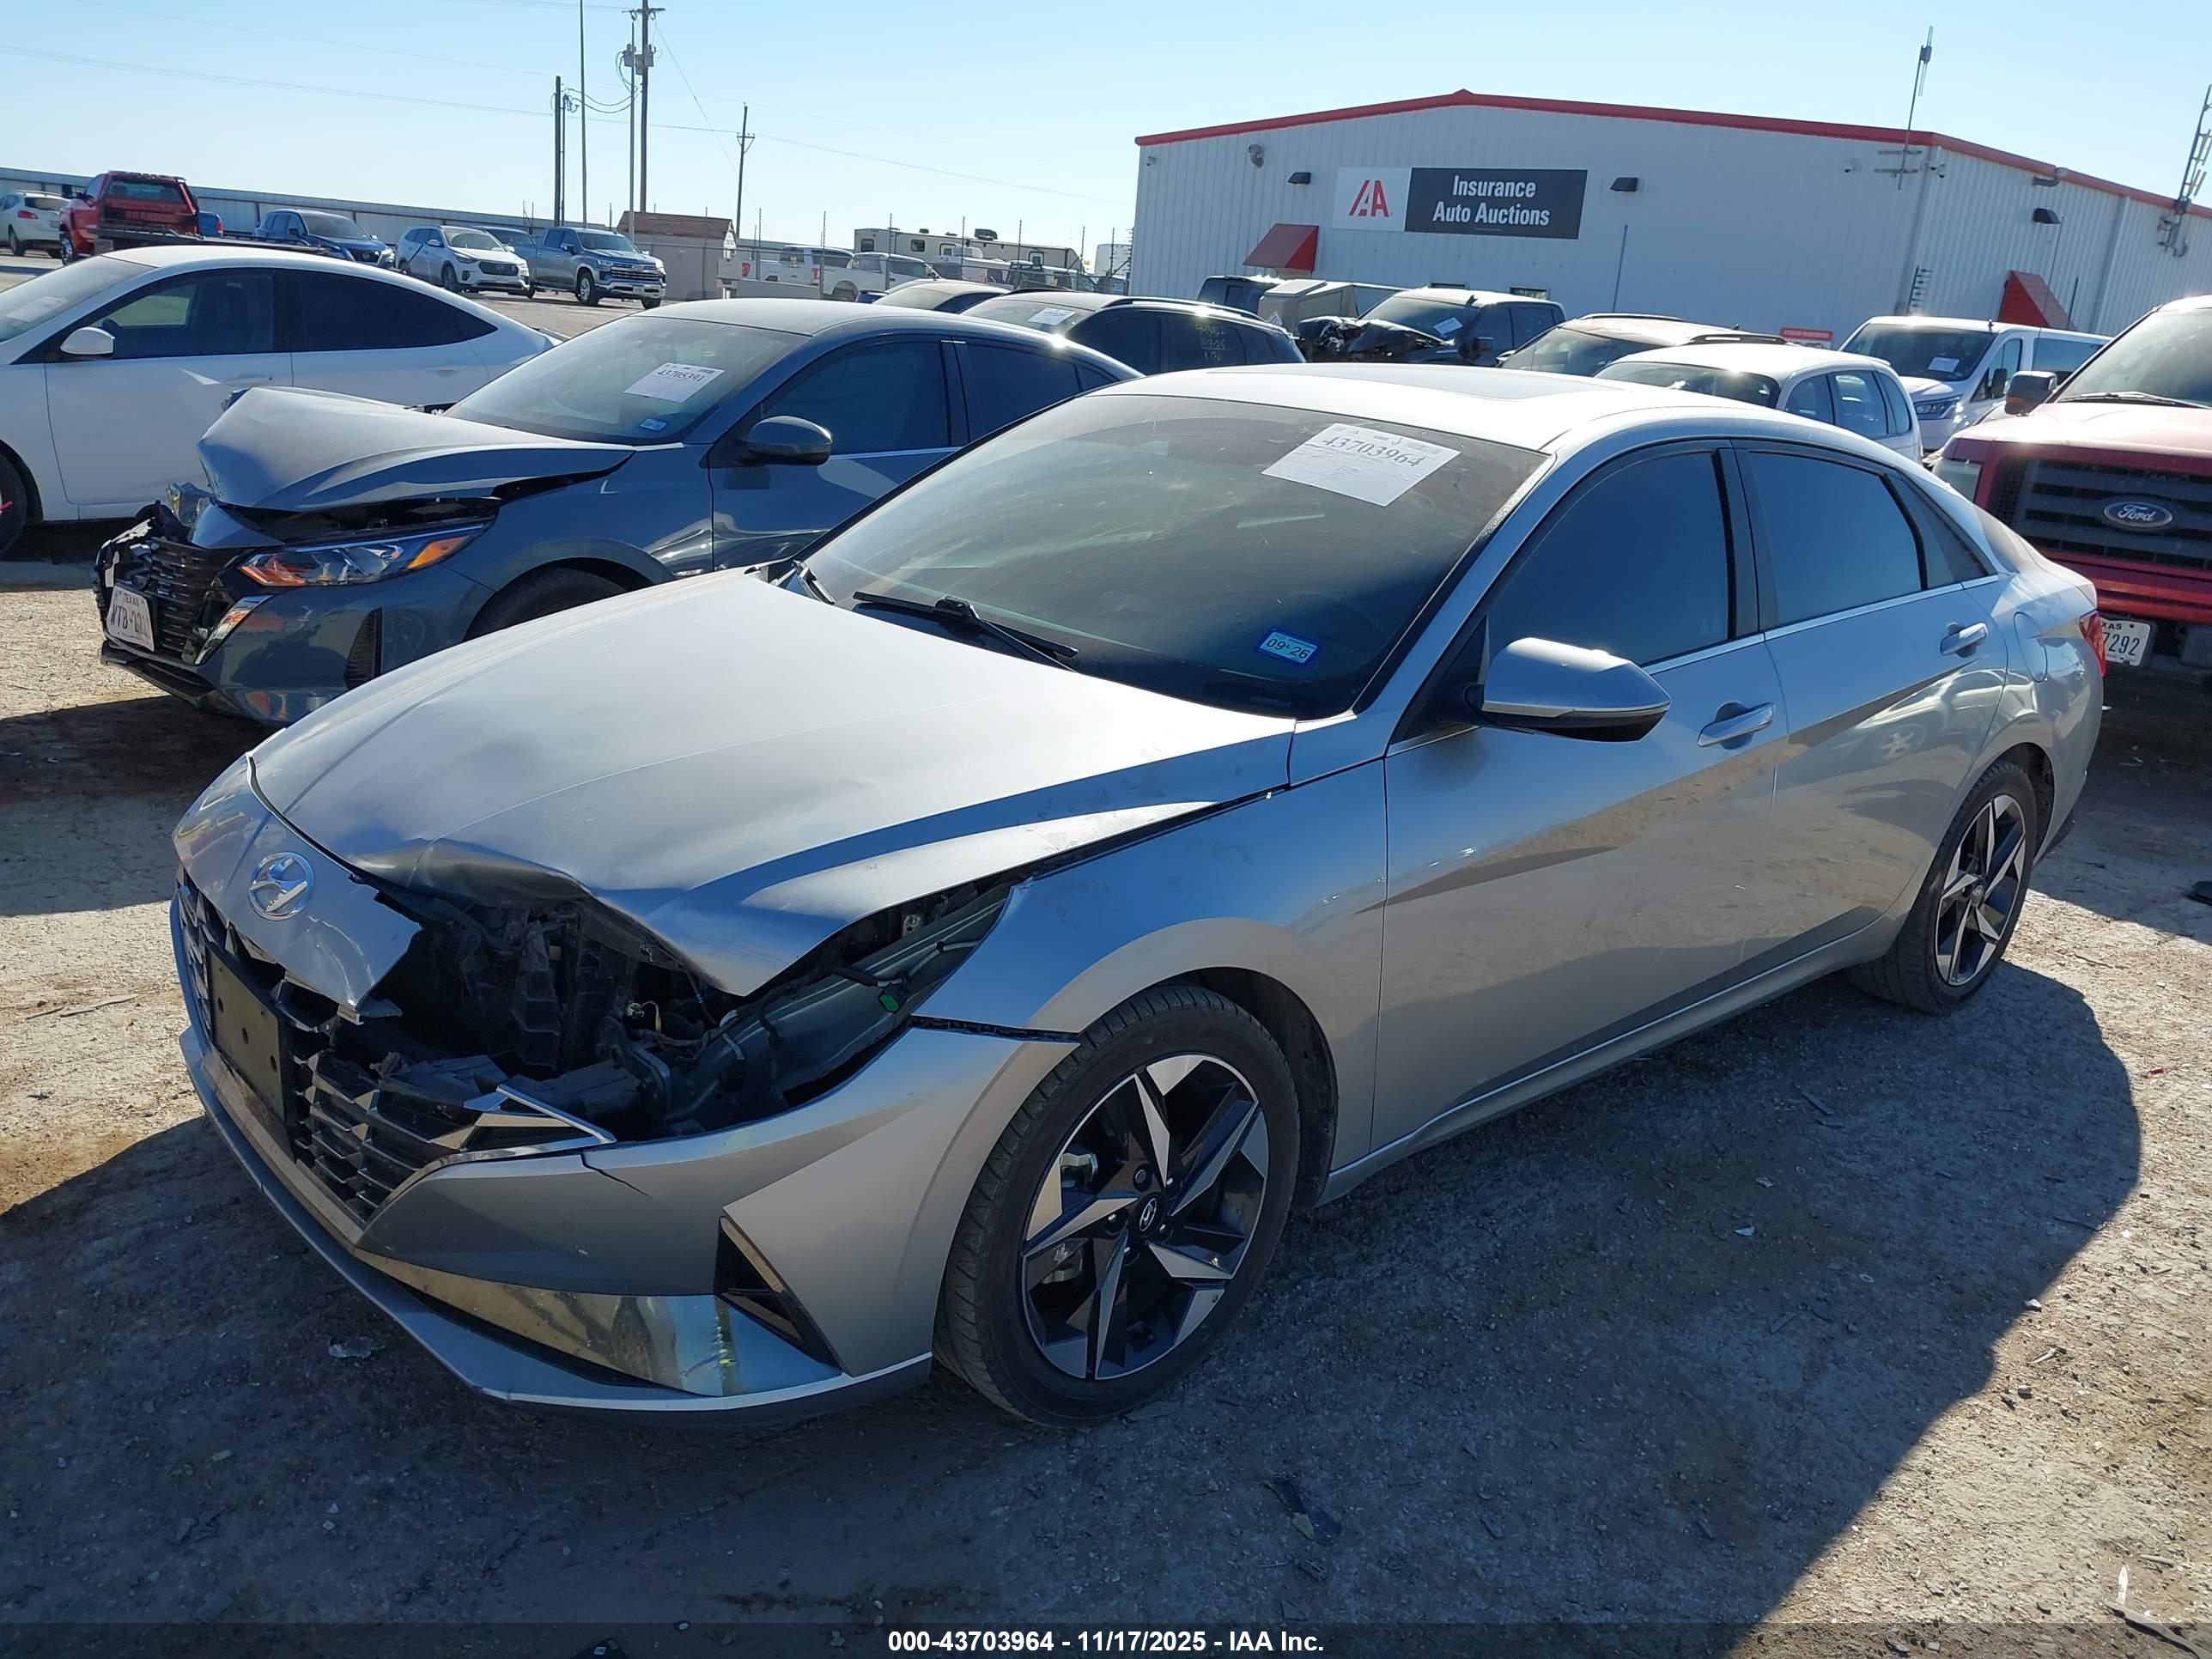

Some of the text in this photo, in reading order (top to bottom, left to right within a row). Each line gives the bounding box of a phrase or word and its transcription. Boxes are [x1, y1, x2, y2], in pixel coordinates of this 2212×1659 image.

[1453, 175, 1536, 198] Insurance
[1432, 201, 1551, 226] Auto Auctions
[1322, 436, 1426, 467] 43703964
[2118, 504, 2156, 522] Ford
[2101, 621, 2123, 631] XAS
[2103, 632, 2141, 656] 7292
